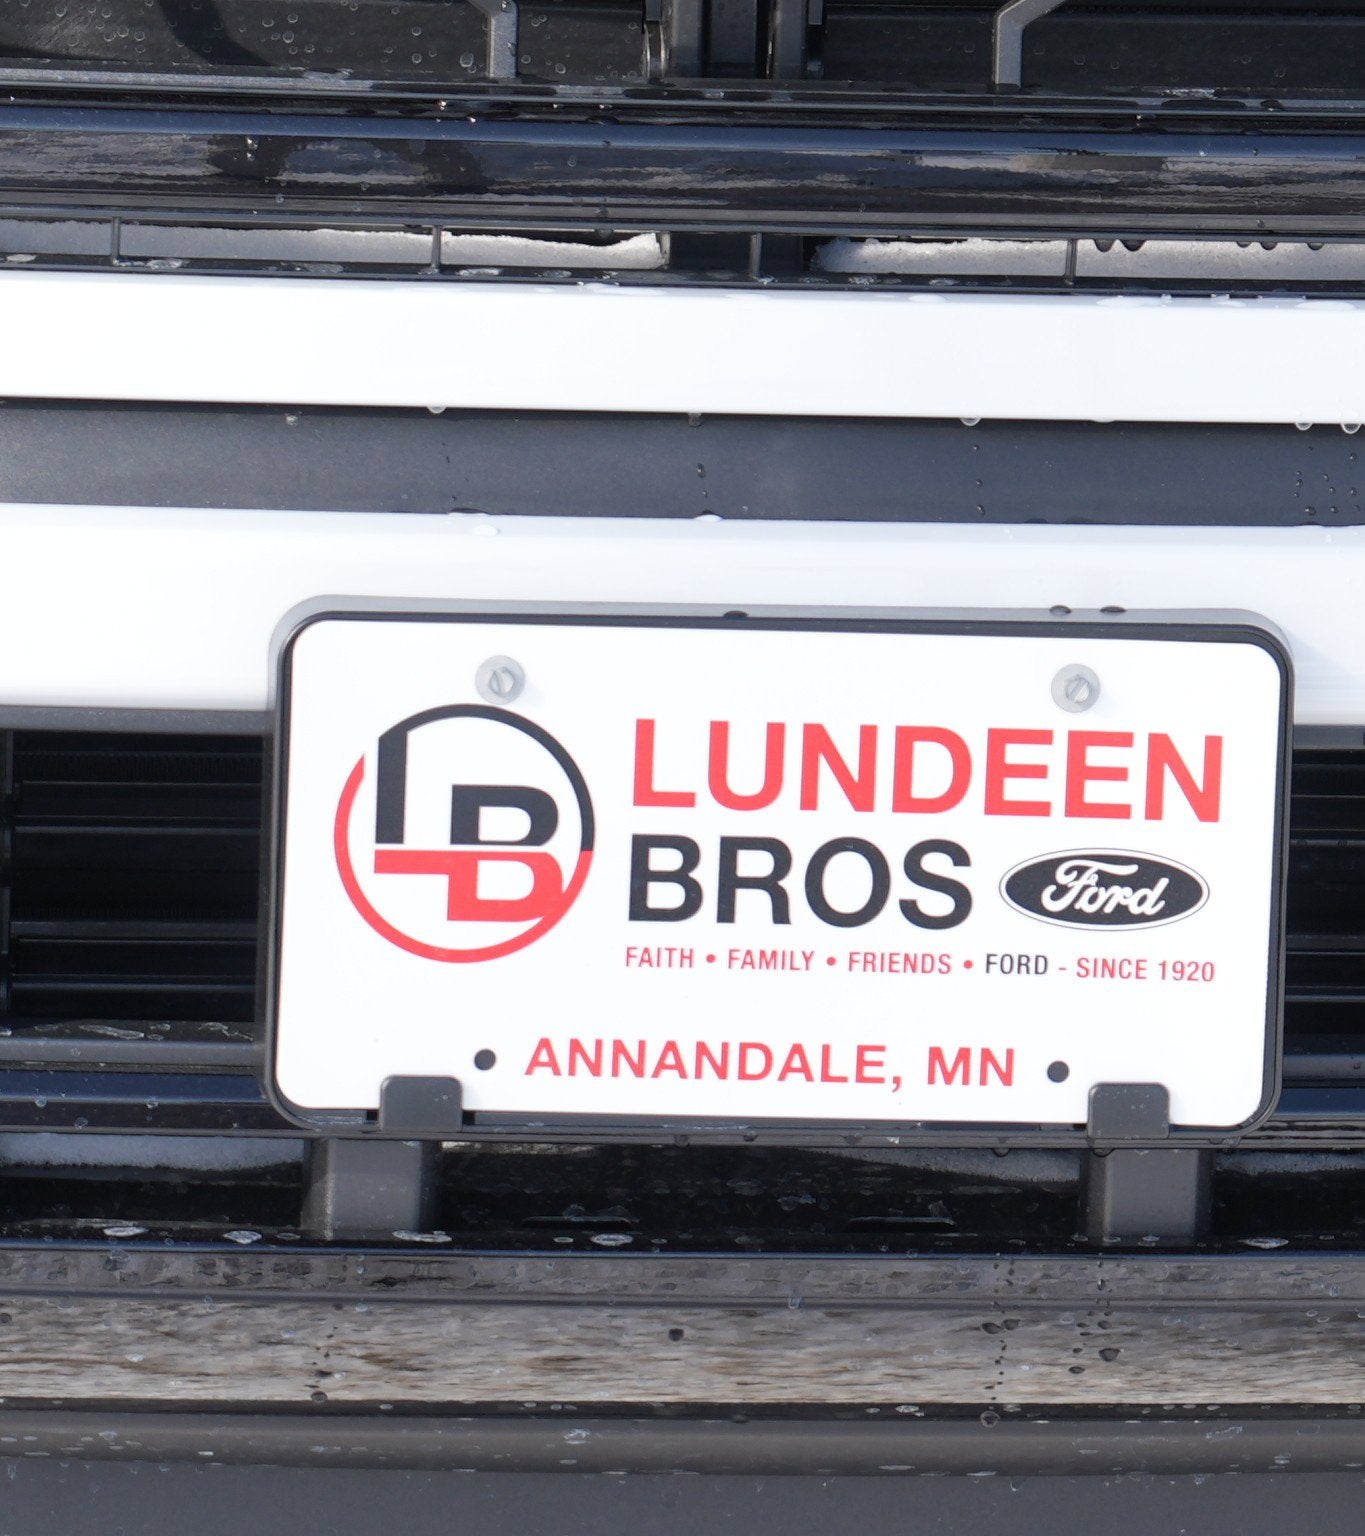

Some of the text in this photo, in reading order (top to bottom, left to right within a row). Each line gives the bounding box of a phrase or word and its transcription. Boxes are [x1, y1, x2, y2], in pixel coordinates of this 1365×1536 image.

[632, 718, 1223, 823] LUNDEEN
[628, 833, 973, 930] BROS
[1041, 859, 1170, 916] Ford
[625, 946, 694, 969] FAITH
[727, 949, 815, 972] FAMILY
[847, 951, 952, 975] FRIENDS
[984, 953, 1048, 976] FORD
[1075, 957, 1148, 980] SINCE
[1157, 960, 1216, 982] 1920
[524, 1037, 1014, 1092] ANNANDALE, MN
